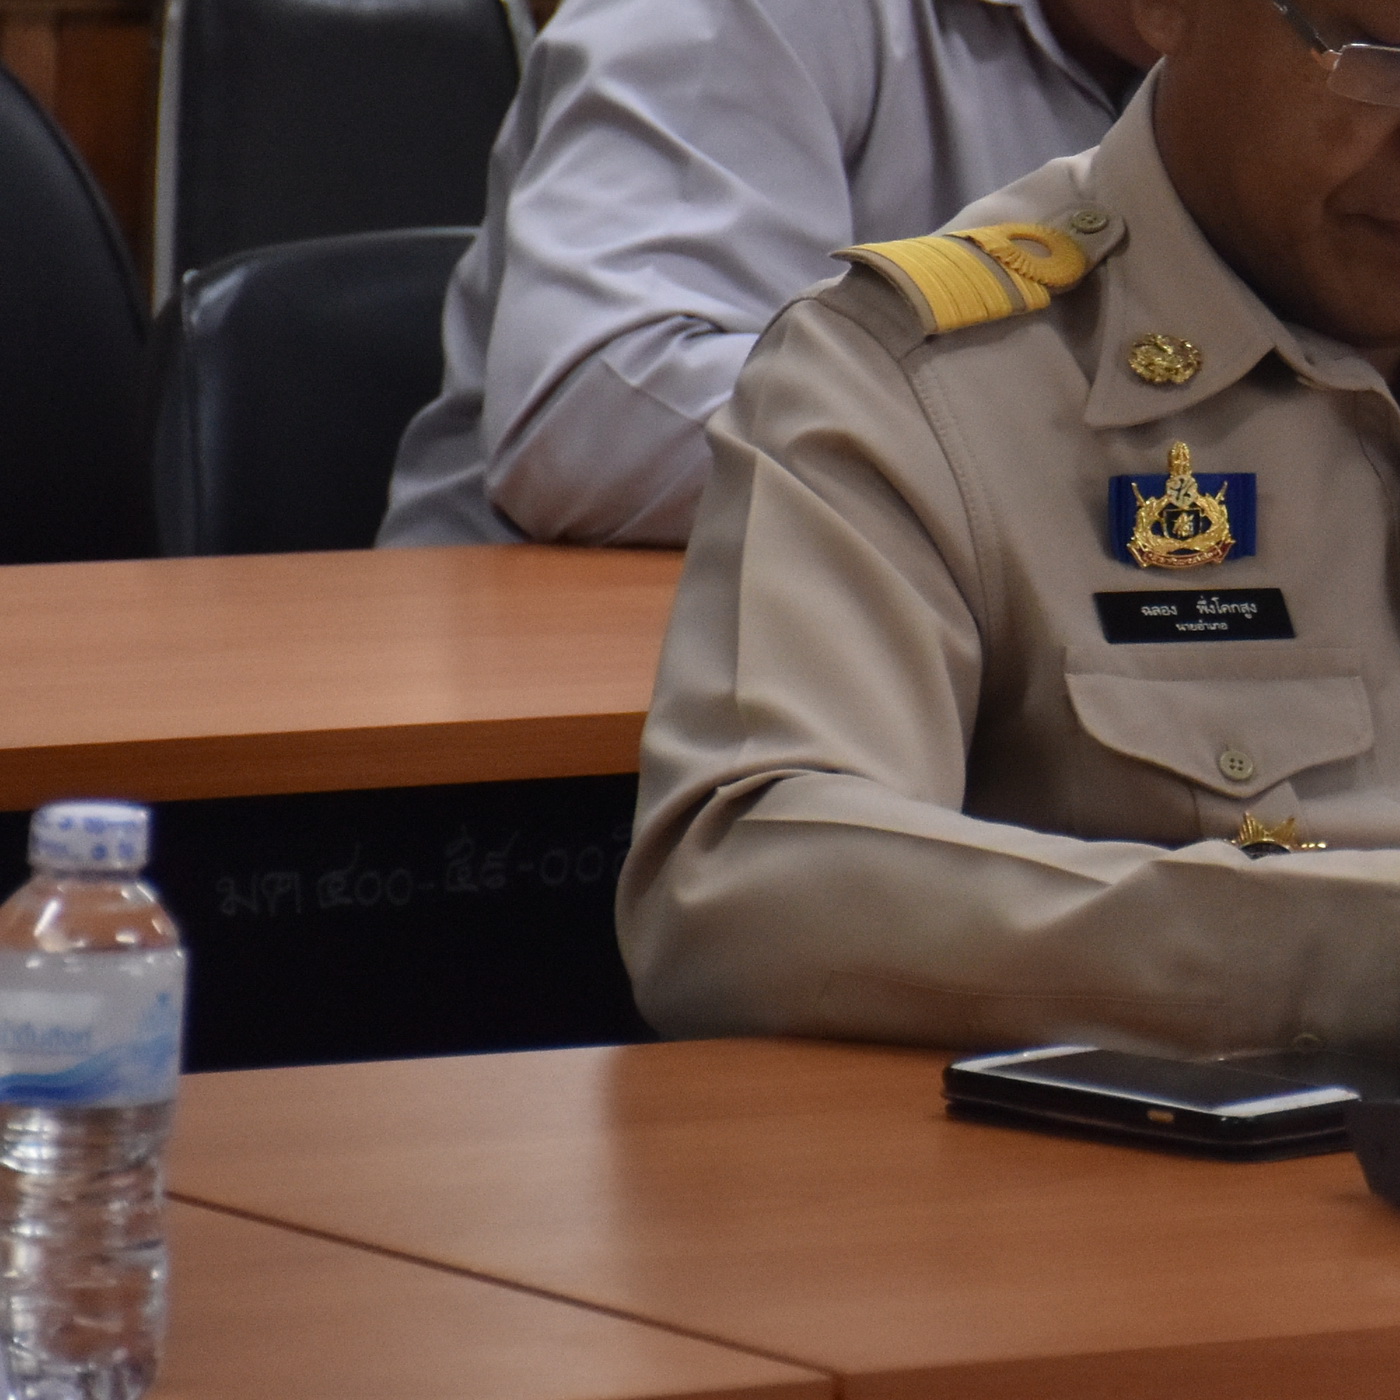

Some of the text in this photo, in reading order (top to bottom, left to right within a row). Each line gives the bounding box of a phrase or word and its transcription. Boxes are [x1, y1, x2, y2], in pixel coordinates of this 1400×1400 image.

[1140, 594, 1258, 619] ฉลอง พึ่งโคกสูง
[1175, 619, 1229, 632] นายอำเภอ
